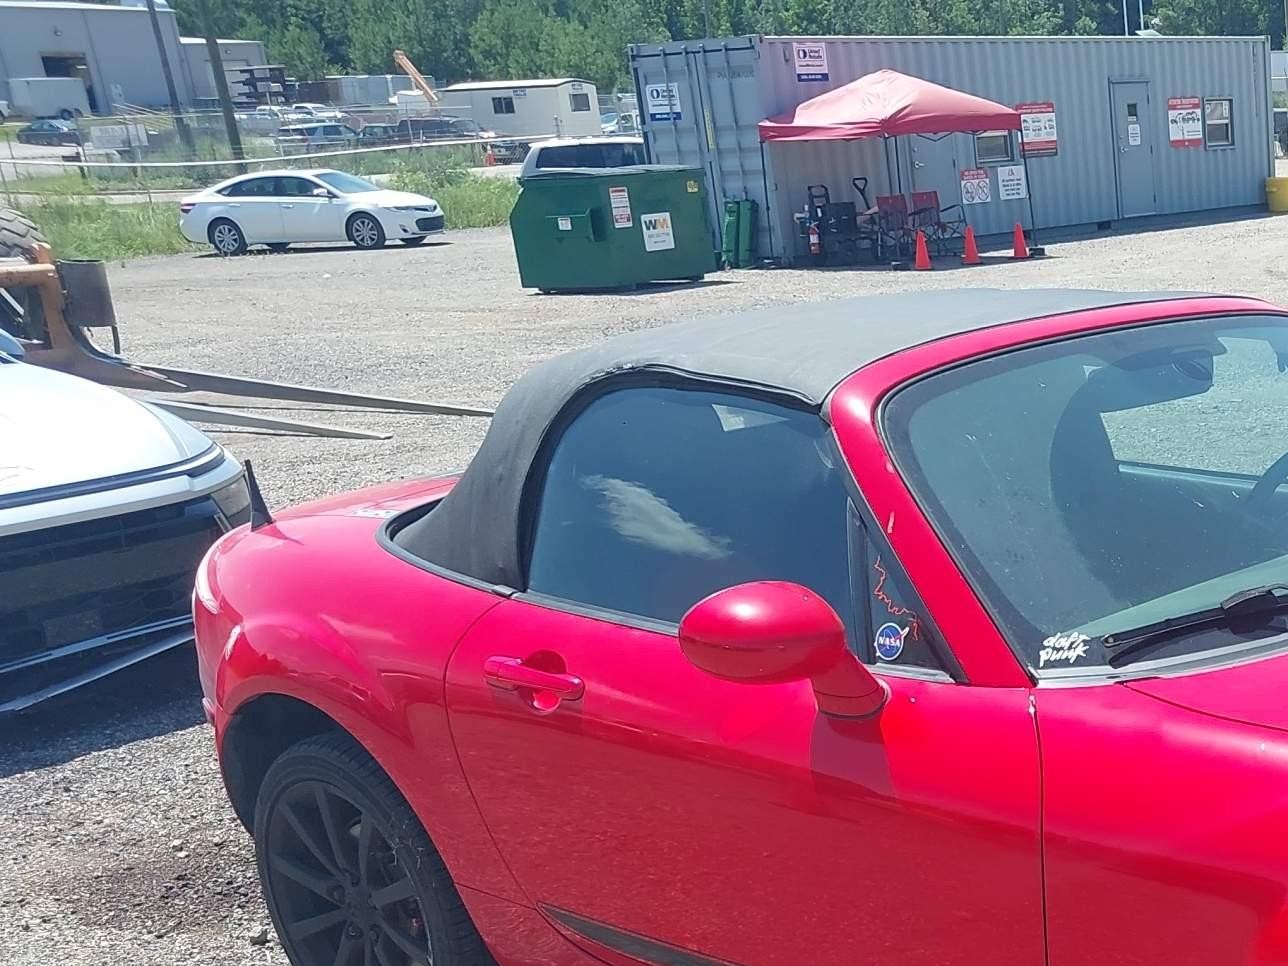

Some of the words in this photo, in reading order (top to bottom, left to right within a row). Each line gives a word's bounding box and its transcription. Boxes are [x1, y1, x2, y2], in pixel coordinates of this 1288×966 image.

[644, 217, 669, 231] WM
[878, 636, 901, 647] NASA
[1039, 642, 1089, 667] punk
